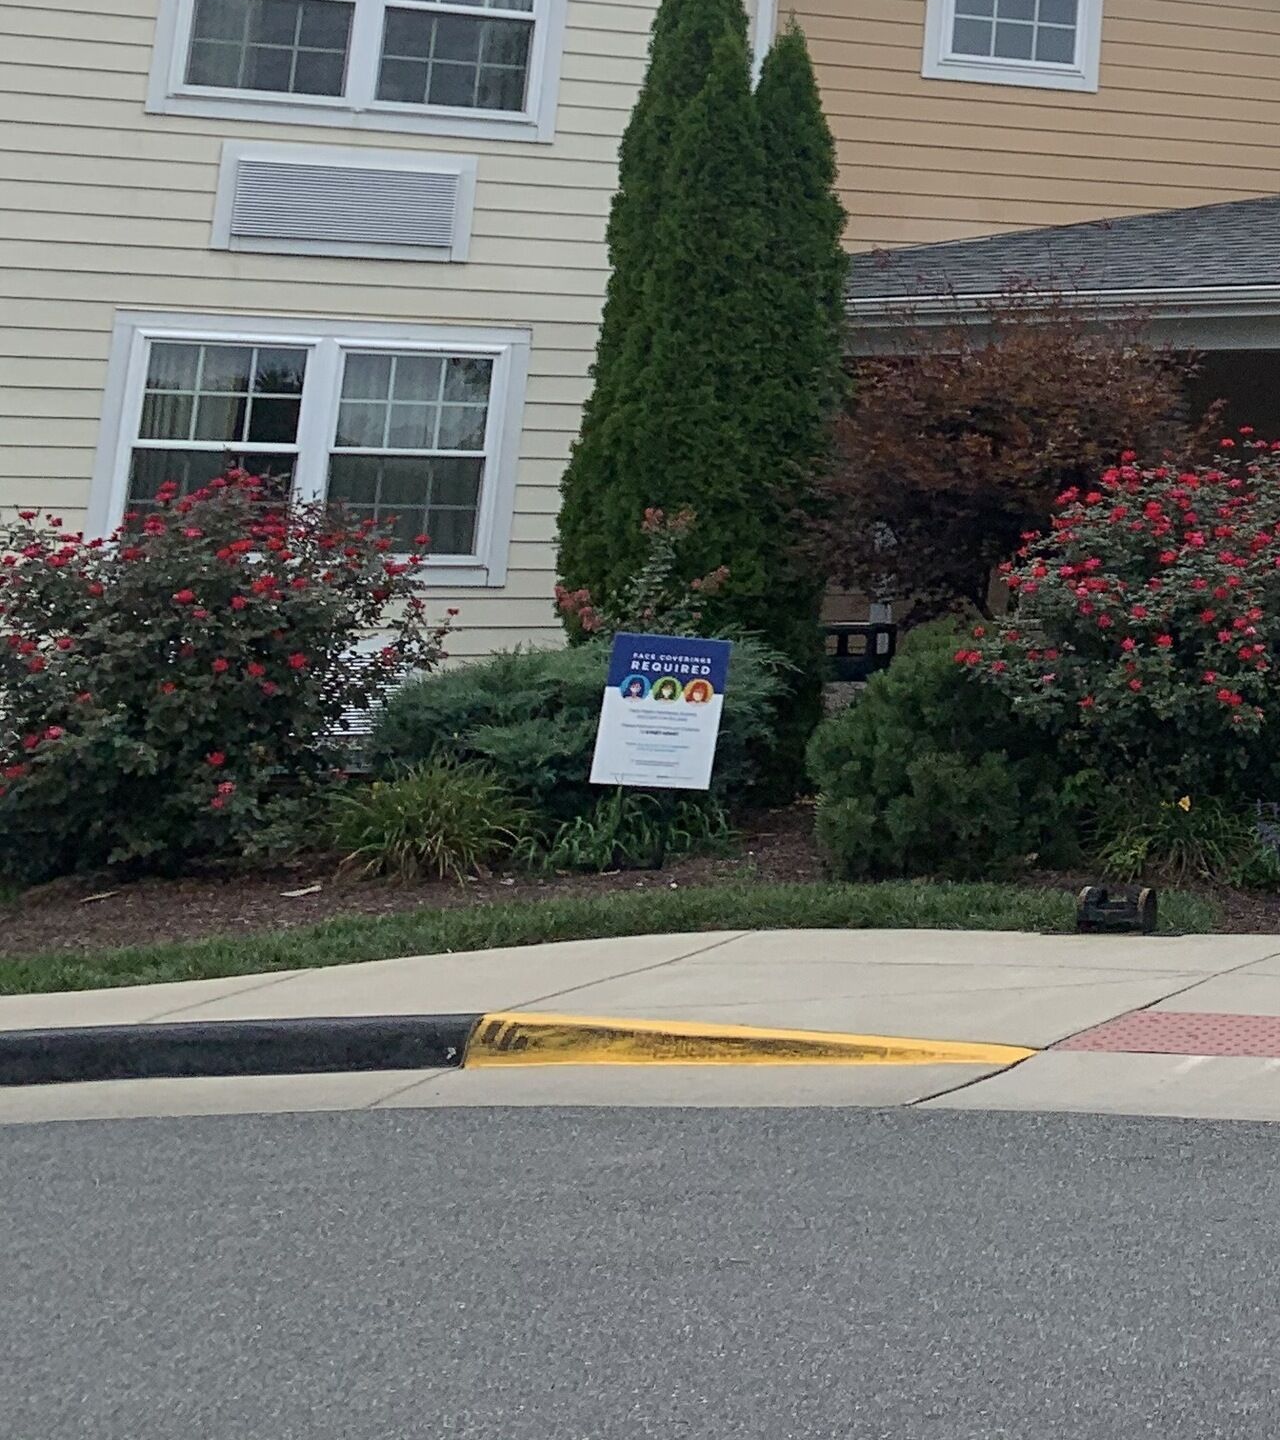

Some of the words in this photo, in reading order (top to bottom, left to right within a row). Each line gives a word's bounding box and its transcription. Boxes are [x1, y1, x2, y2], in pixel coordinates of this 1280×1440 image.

[632, 652, 656, 660] FACE
[659, 654, 712, 664] COVERINGS
[631, 660, 711, 675] REQUIRED
